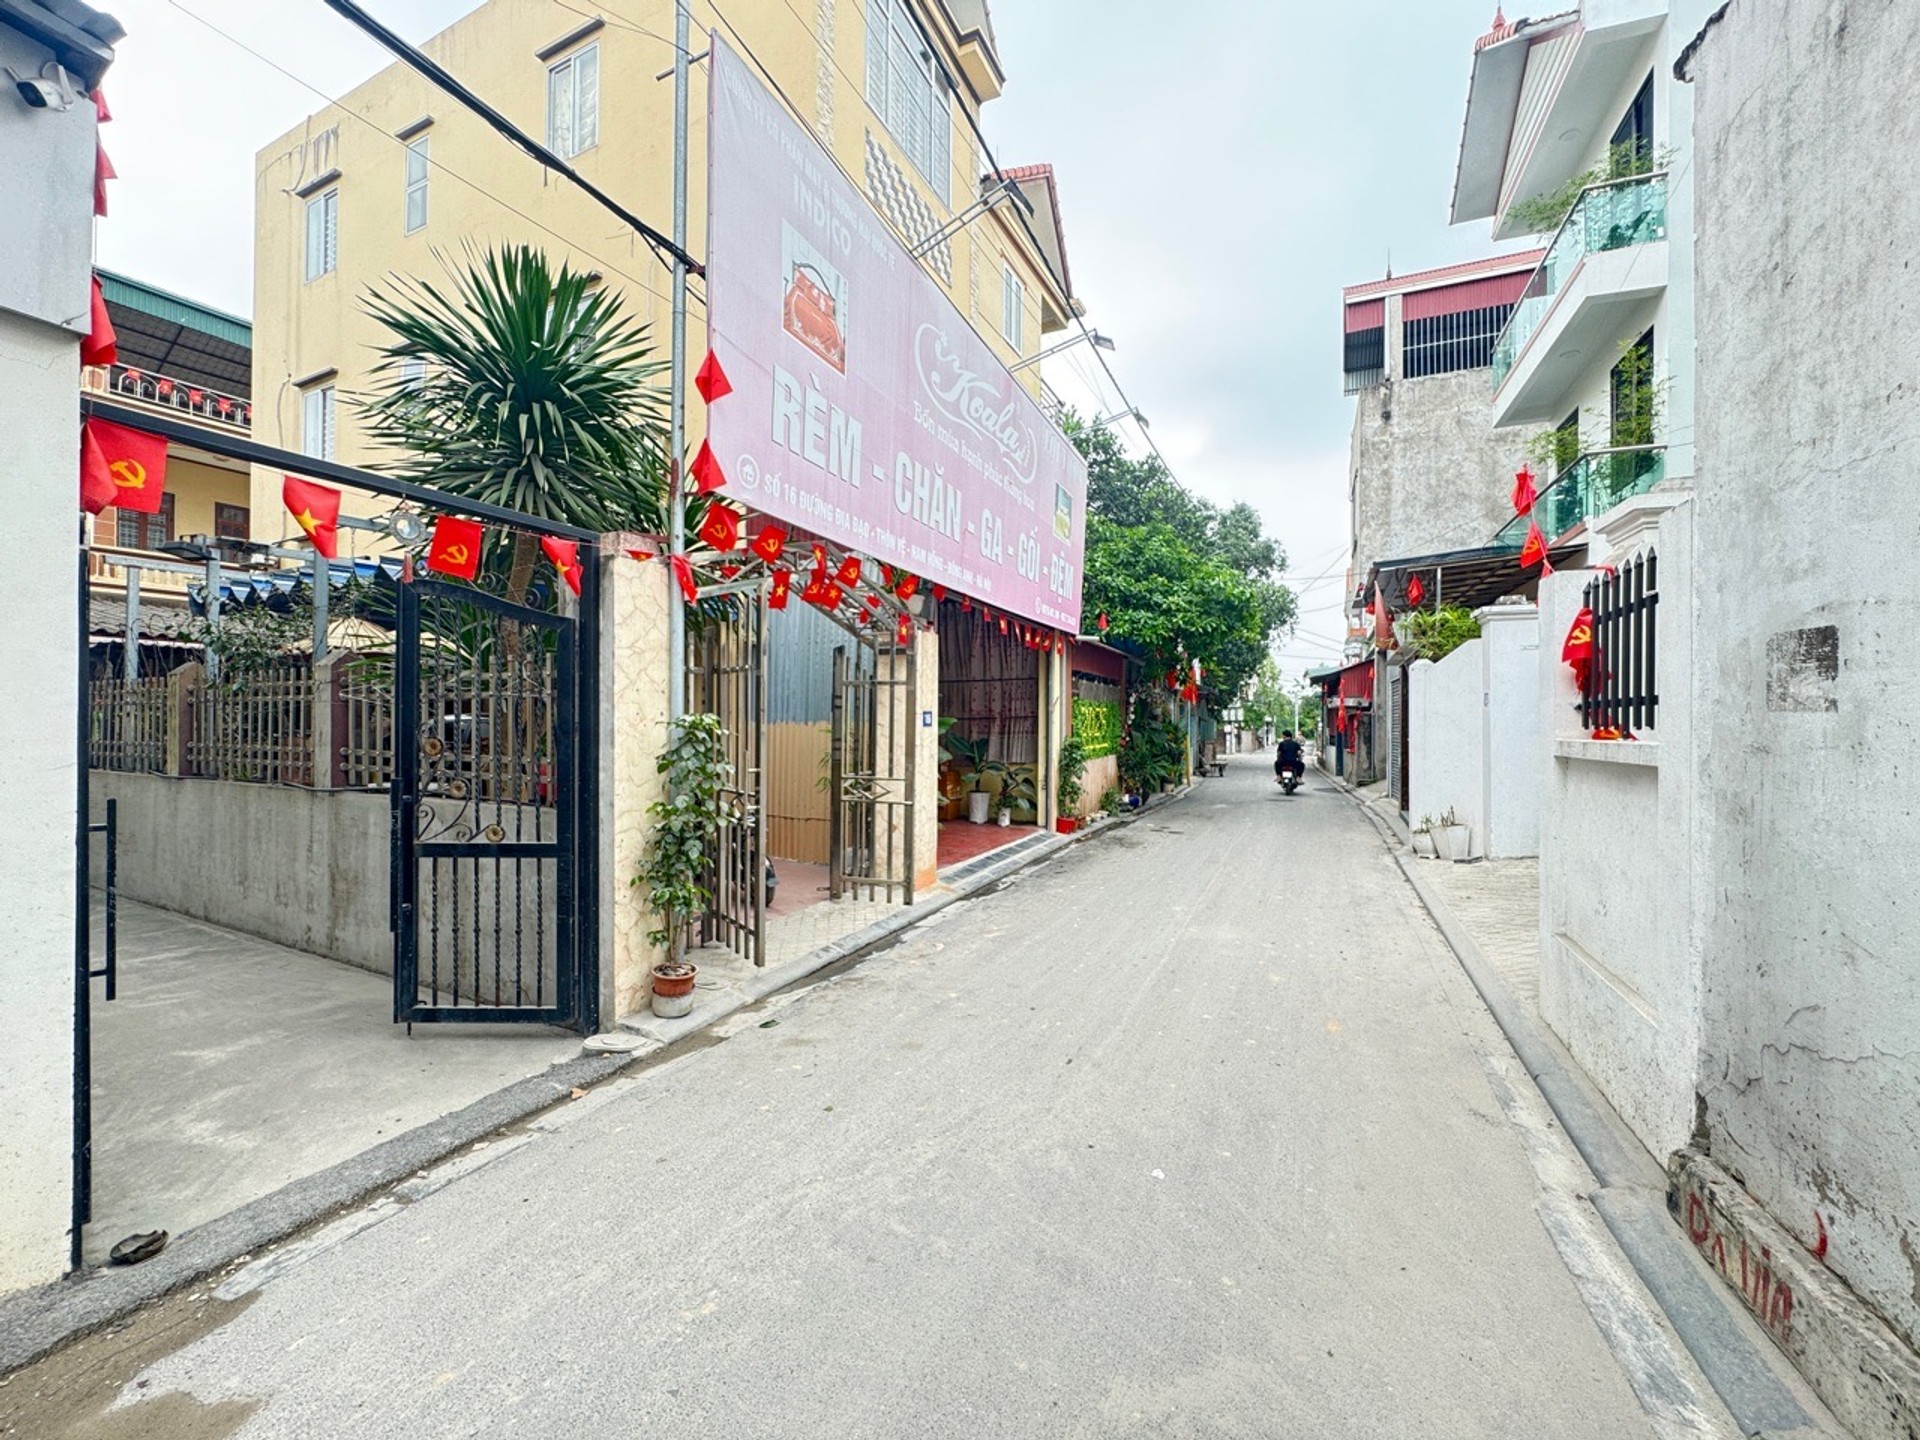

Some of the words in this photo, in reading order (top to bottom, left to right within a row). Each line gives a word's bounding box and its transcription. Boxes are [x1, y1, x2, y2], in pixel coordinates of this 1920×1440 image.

[793, 175, 851, 256] INDICO
[913, 401, 934, 434] Bốn
[961, 440, 982, 474] hạnh
[765, 472, 780, 497] SỐ
[784, 484, 797, 505] 16
[799, 489, 832, 521] ĐƯỜNG
[836, 508, 849, 532] ĐỊA
[853, 518, 868, 541] ĐẠO
[771, 363, 861, 489] RÈM
[895, 451, 962, 542] CHĂN
[981, 509, 1002, 563] GA
[1018, 525, 1040, 583] GỐI
[1050, 552, 1073, 603] ĐỆM
